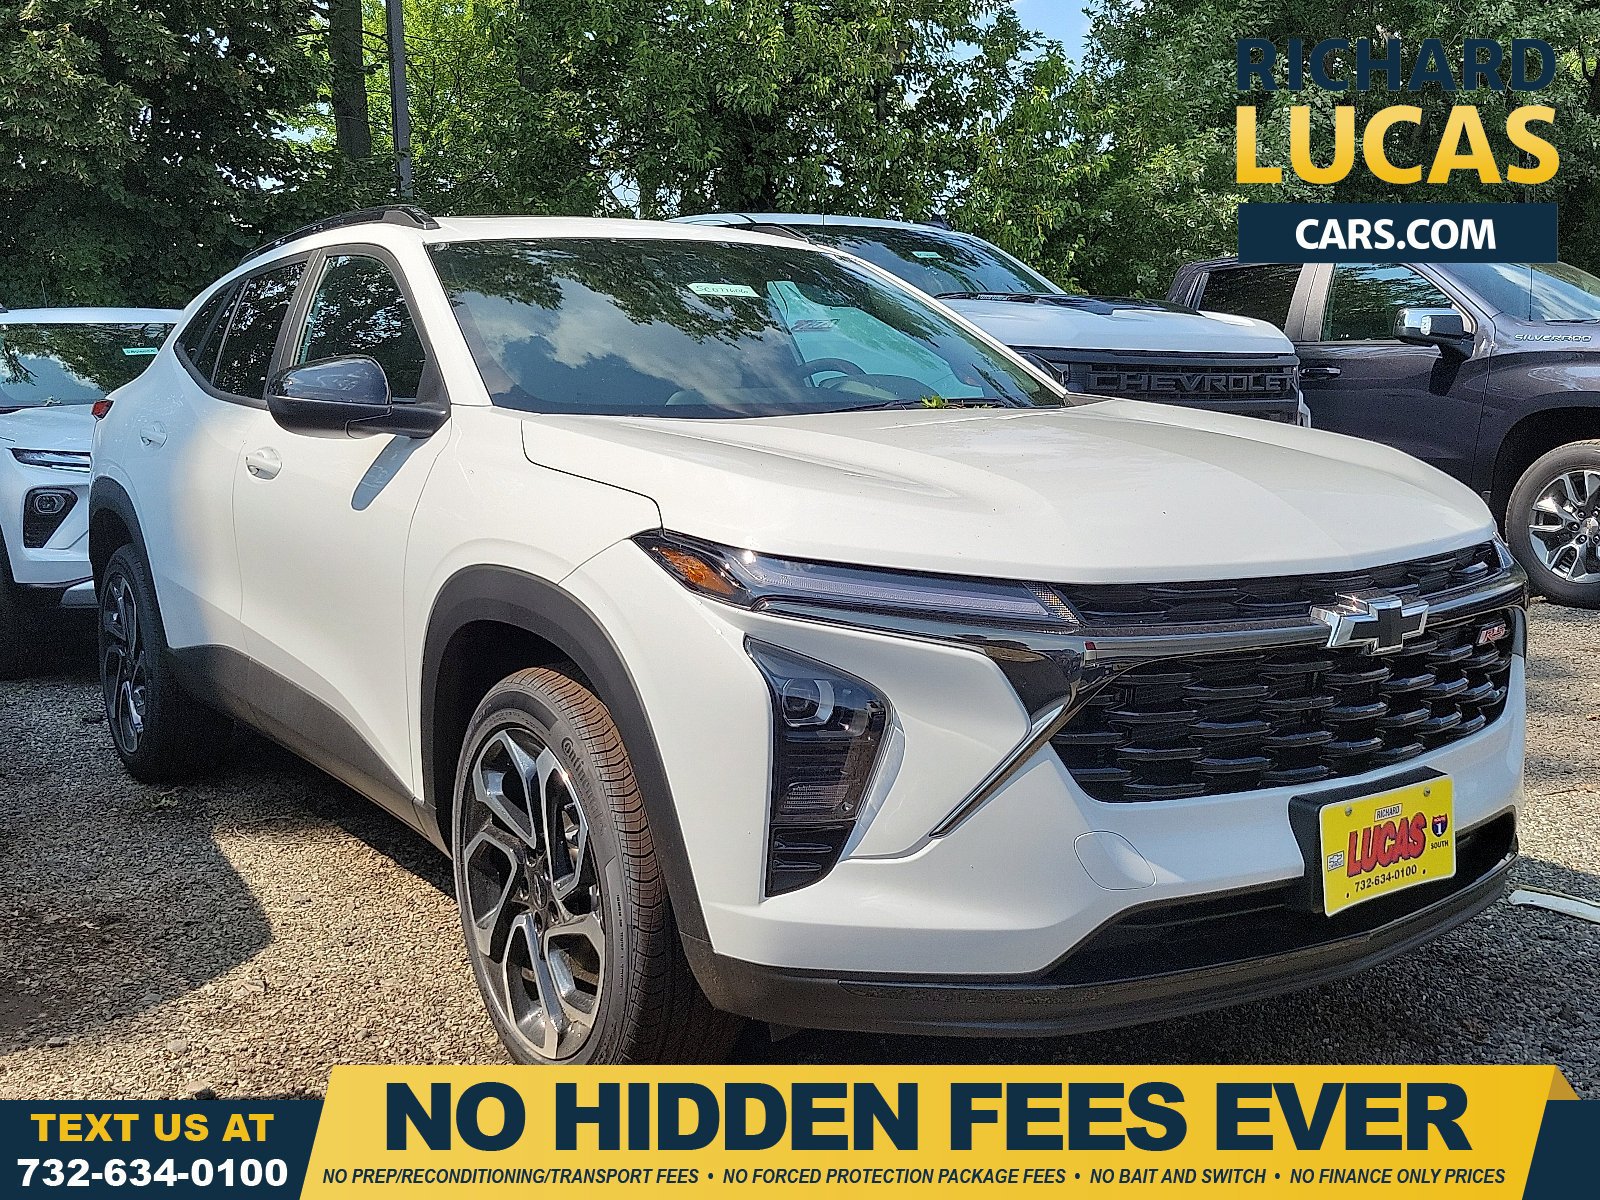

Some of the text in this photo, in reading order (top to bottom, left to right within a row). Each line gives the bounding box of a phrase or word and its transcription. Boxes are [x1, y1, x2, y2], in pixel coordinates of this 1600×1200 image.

[1514, 334, 1592, 343] SILVERADO
[1089, 373, 1294, 392] CHEVROLET
[1481, 623, 1506, 643] RS
[1376, 805, 1401, 820] RICHARD
[1347, 812, 1427, 877] LUCAS
[1430, 840, 1449, 850] SOUTH
[1354, 864, 1417, 892] 732-634-0100
